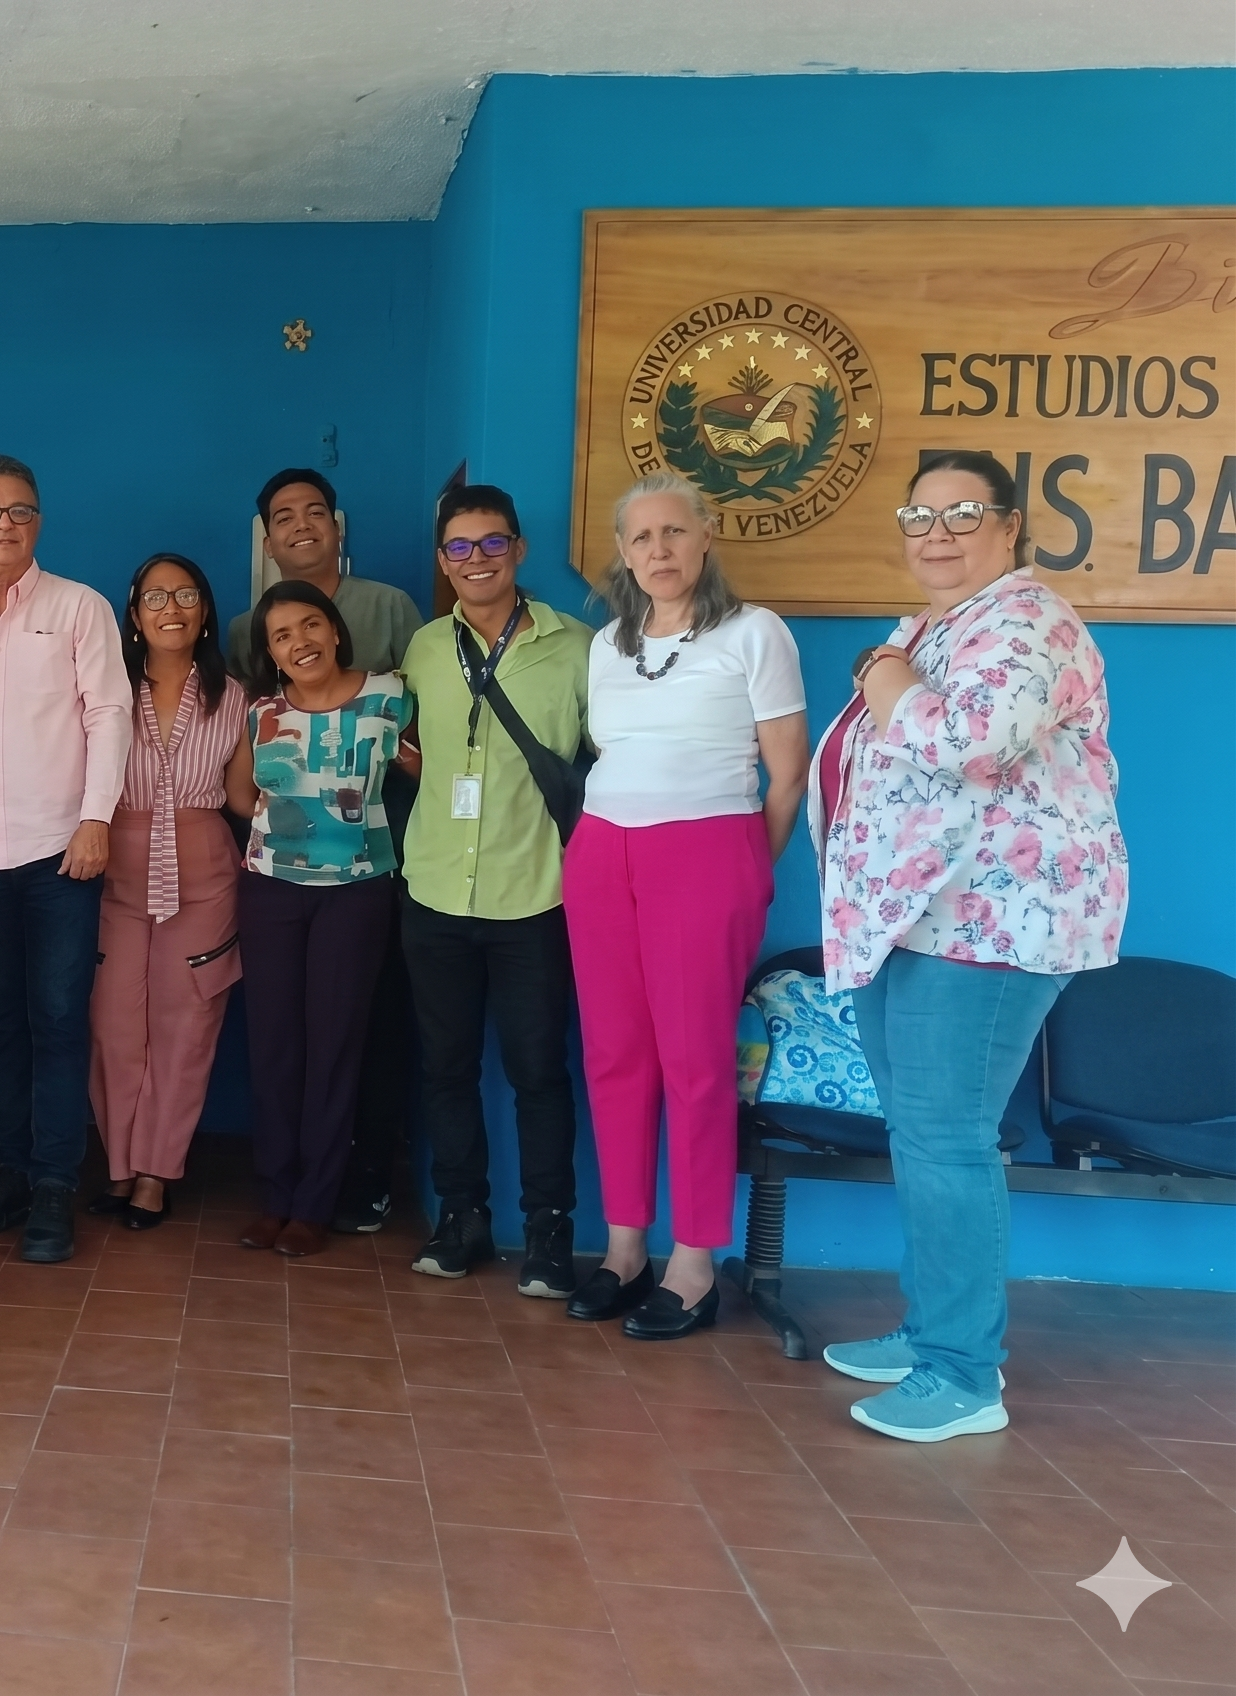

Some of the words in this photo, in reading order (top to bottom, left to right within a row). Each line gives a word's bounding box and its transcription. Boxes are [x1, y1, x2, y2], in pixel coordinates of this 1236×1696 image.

[629, 296, 773, 405] UNIVERSIDAD
[783, 303, 873, 402] CENTRAL
[919, 353, 1220, 419] ESTUDIOS
[631, 440, 661, 476] DE
[735, 441, 873, 537] VENEZUELA
[1138, 453, 1236, 575] BA
